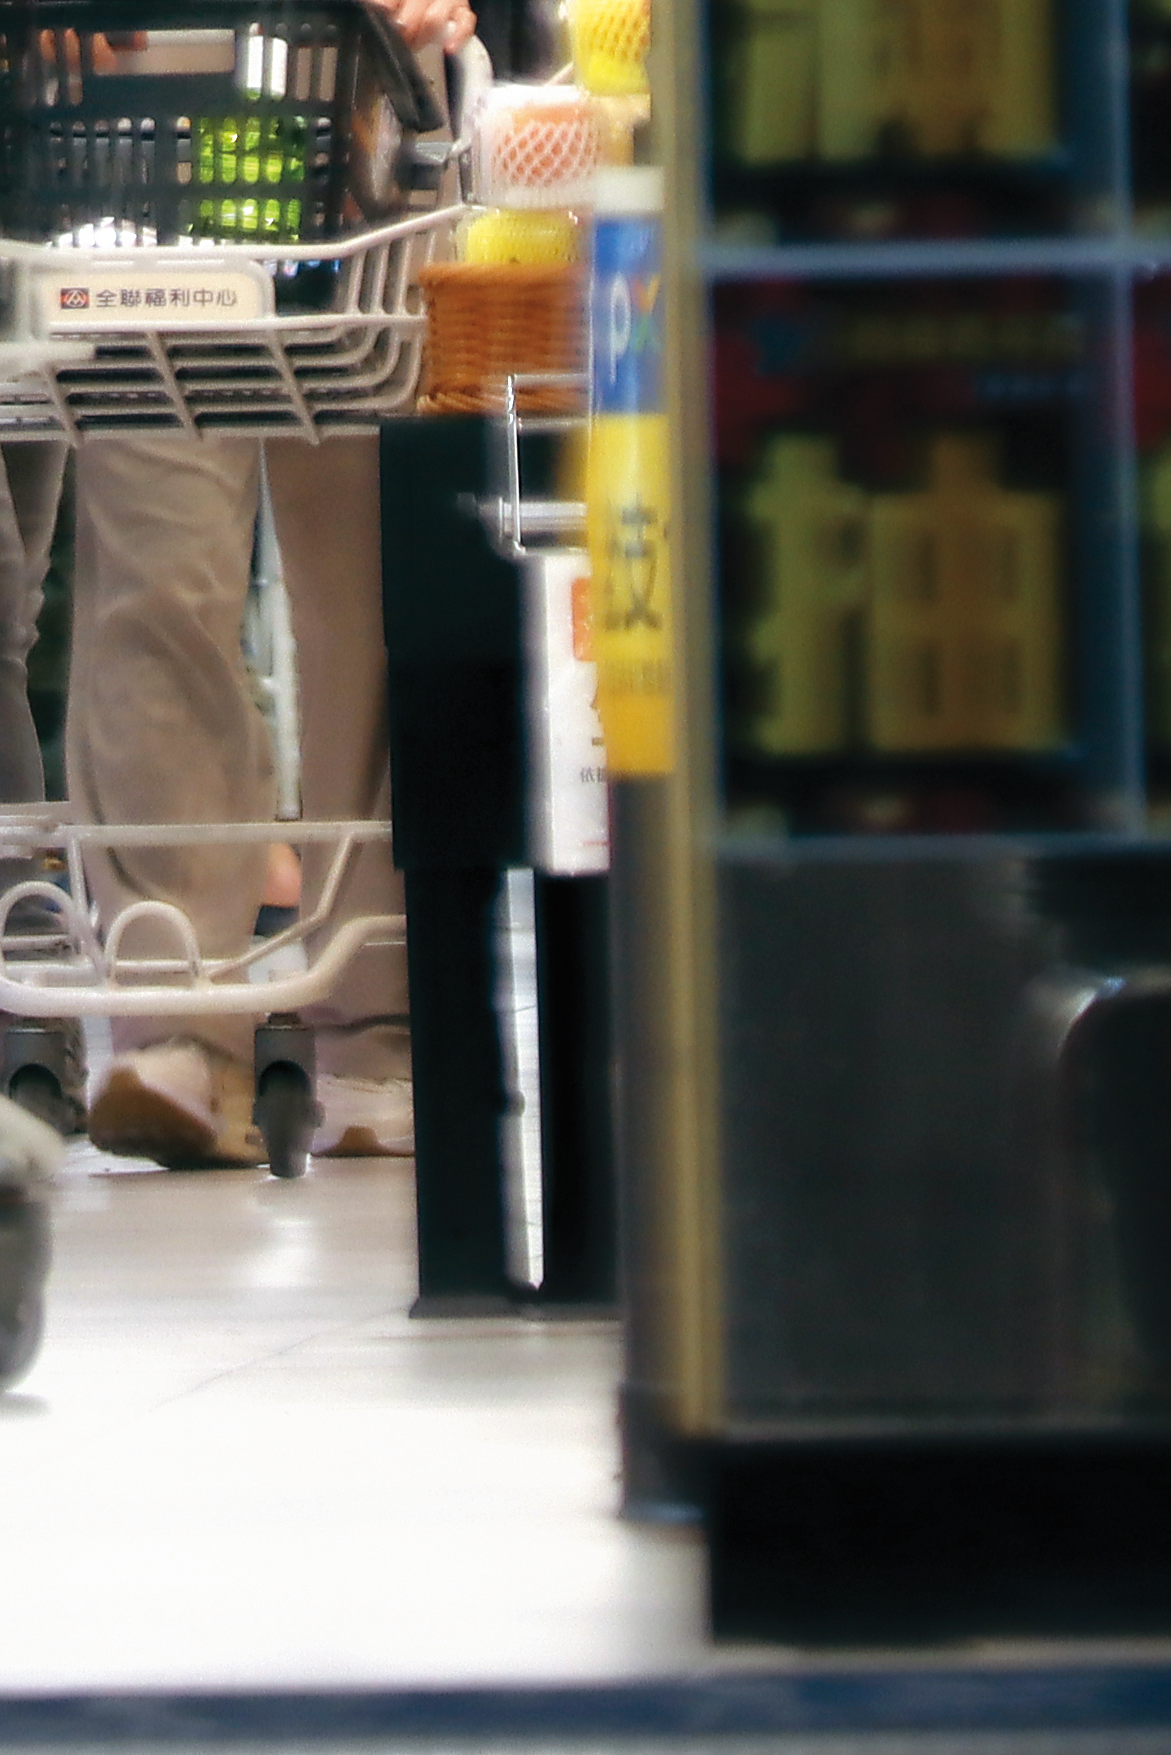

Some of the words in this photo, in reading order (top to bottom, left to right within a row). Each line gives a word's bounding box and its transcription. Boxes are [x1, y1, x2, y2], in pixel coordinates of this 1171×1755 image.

[96, 288, 237, 308] 全聯福利中心
